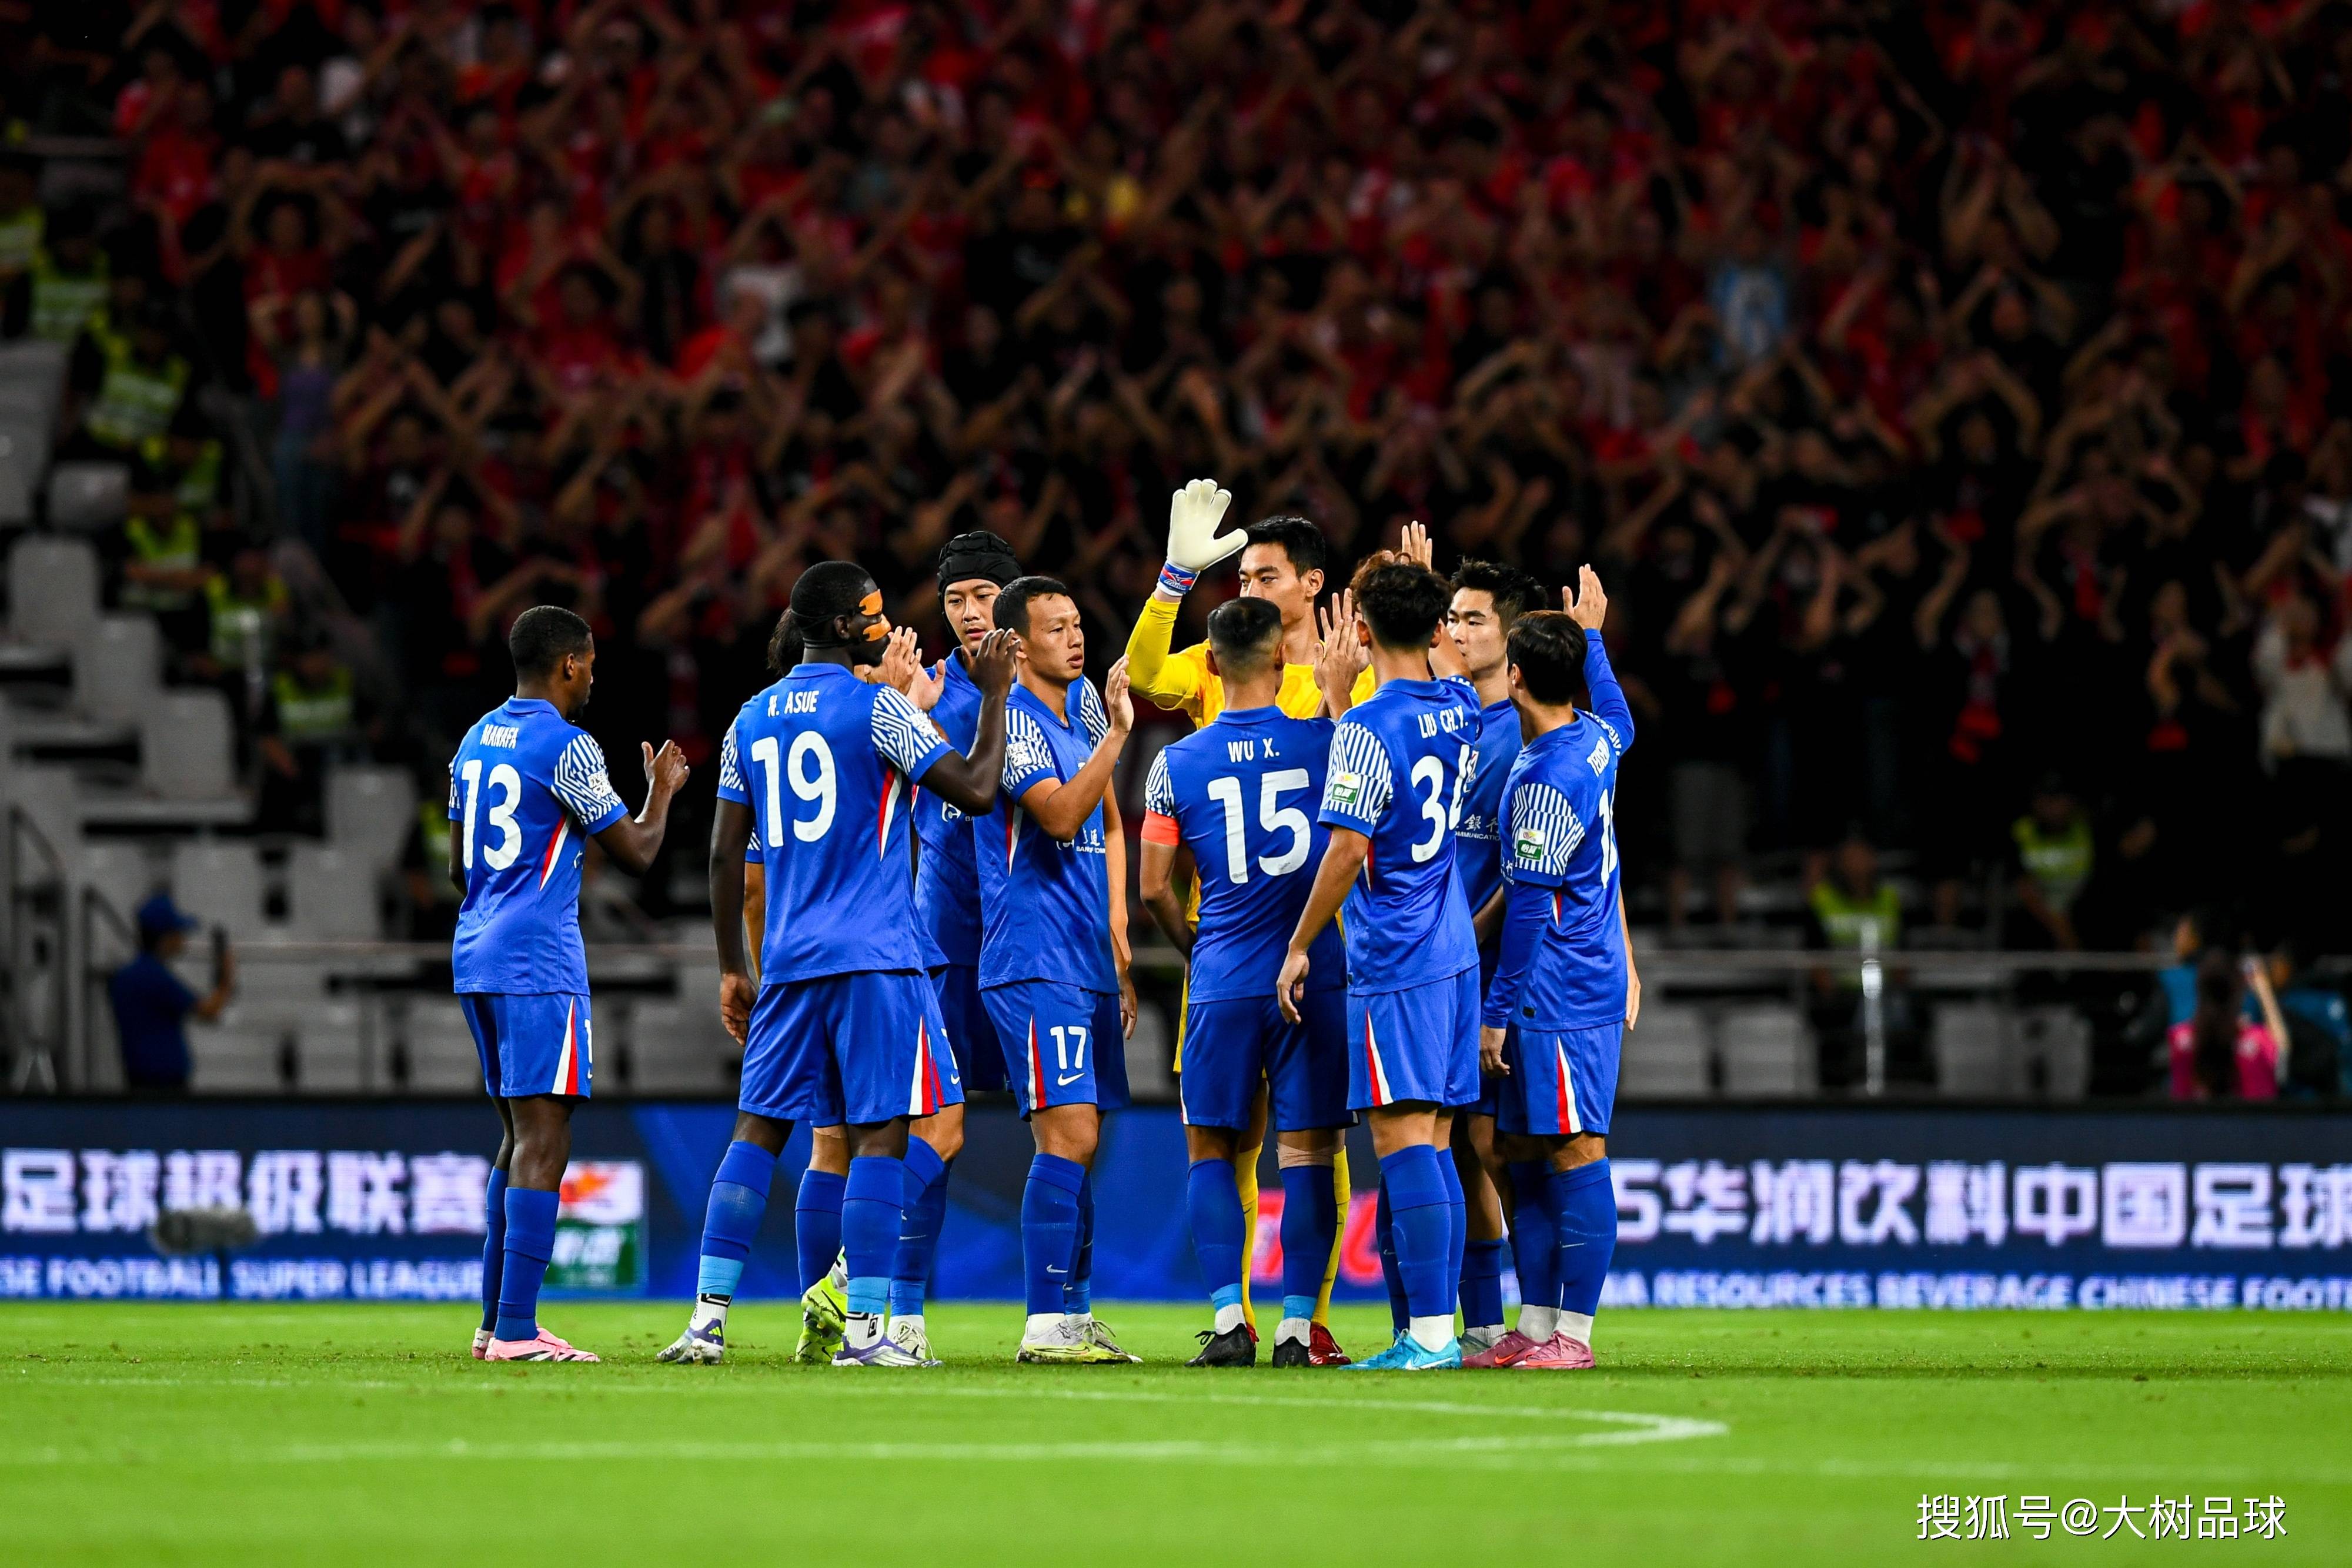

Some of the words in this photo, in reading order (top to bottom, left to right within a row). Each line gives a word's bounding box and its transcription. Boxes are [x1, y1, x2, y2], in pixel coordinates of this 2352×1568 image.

[767, 694, 780, 717] N.
[784, 690, 820, 714] ASUE
[1418, 713, 1438, 739] LIU
[1439, 705, 1469, 733] CH.Y.
[479, 724, 519, 749] MANAFA
[1227, 740, 1254, 763] WU
[1262, 738, 1280, 758] X.
[751, 730, 837, 848] 19
[461, 760, 522, 870] 13
[1207, 768, 1311, 884] 15
[1050, 1026, 1086, 1069] 17
[47, 1257, 220, 1296] FOOTBALL
[232, 1259, 348, 1298] SUPER
[352, 1260, 484, 1299] LEAGUE
[1653, 1272, 1869, 1308] RESOURCES
[1877, 1273, 2072, 1309] BEVERAGE
[2079, 1275, 2237, 1309] CHINESE
